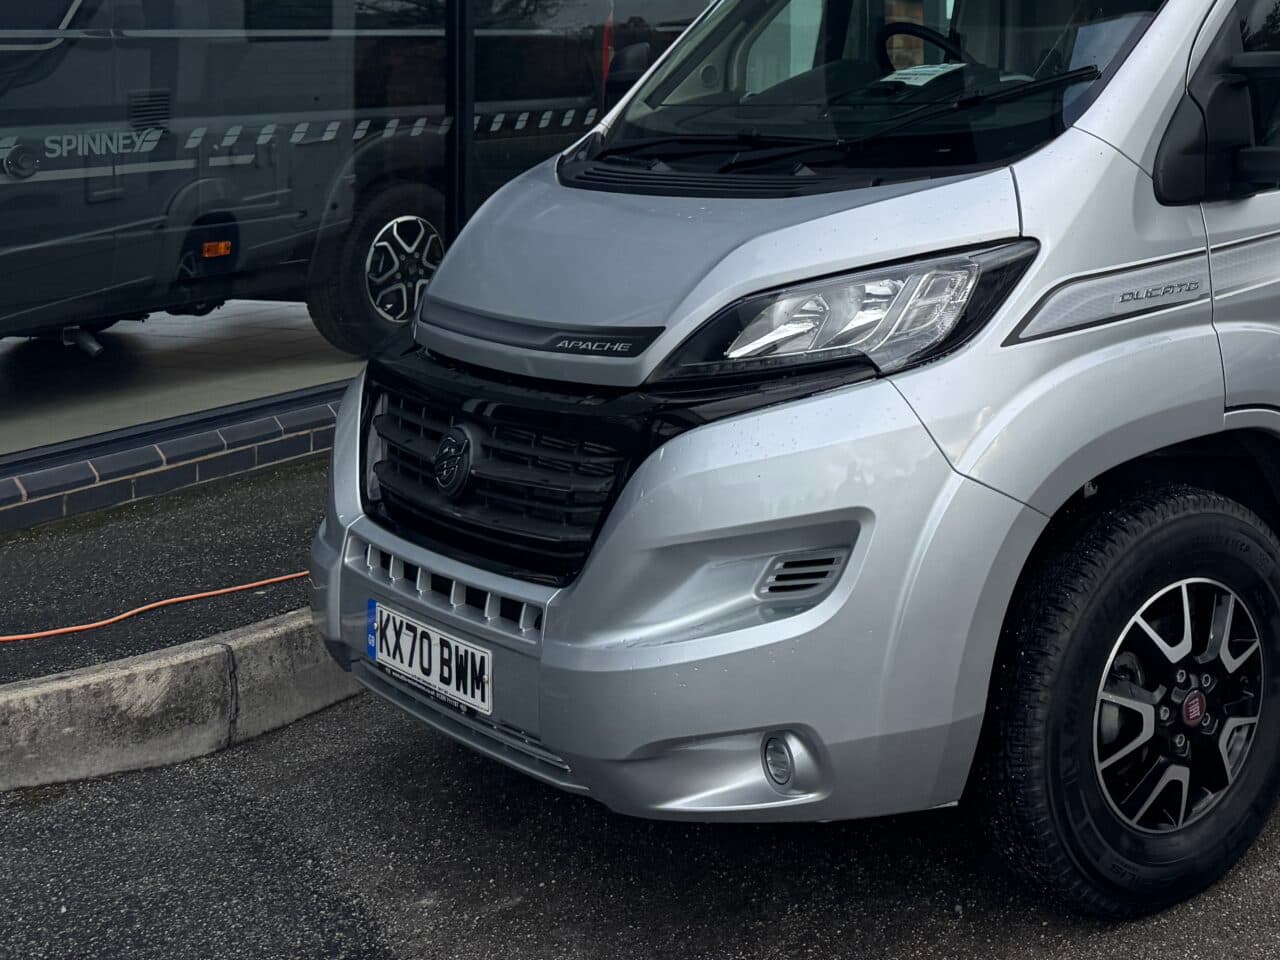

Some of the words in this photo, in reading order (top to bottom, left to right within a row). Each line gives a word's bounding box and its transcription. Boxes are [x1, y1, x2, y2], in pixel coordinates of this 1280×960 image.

[44, 128, 161, 158] SPINNEY
[1119, 281, 1200, 303] DUCATO
[556, 340, 633, 352] APACHE
[379, 609, 432, 678] KX70
[439, 636, 486, 704] BWM
